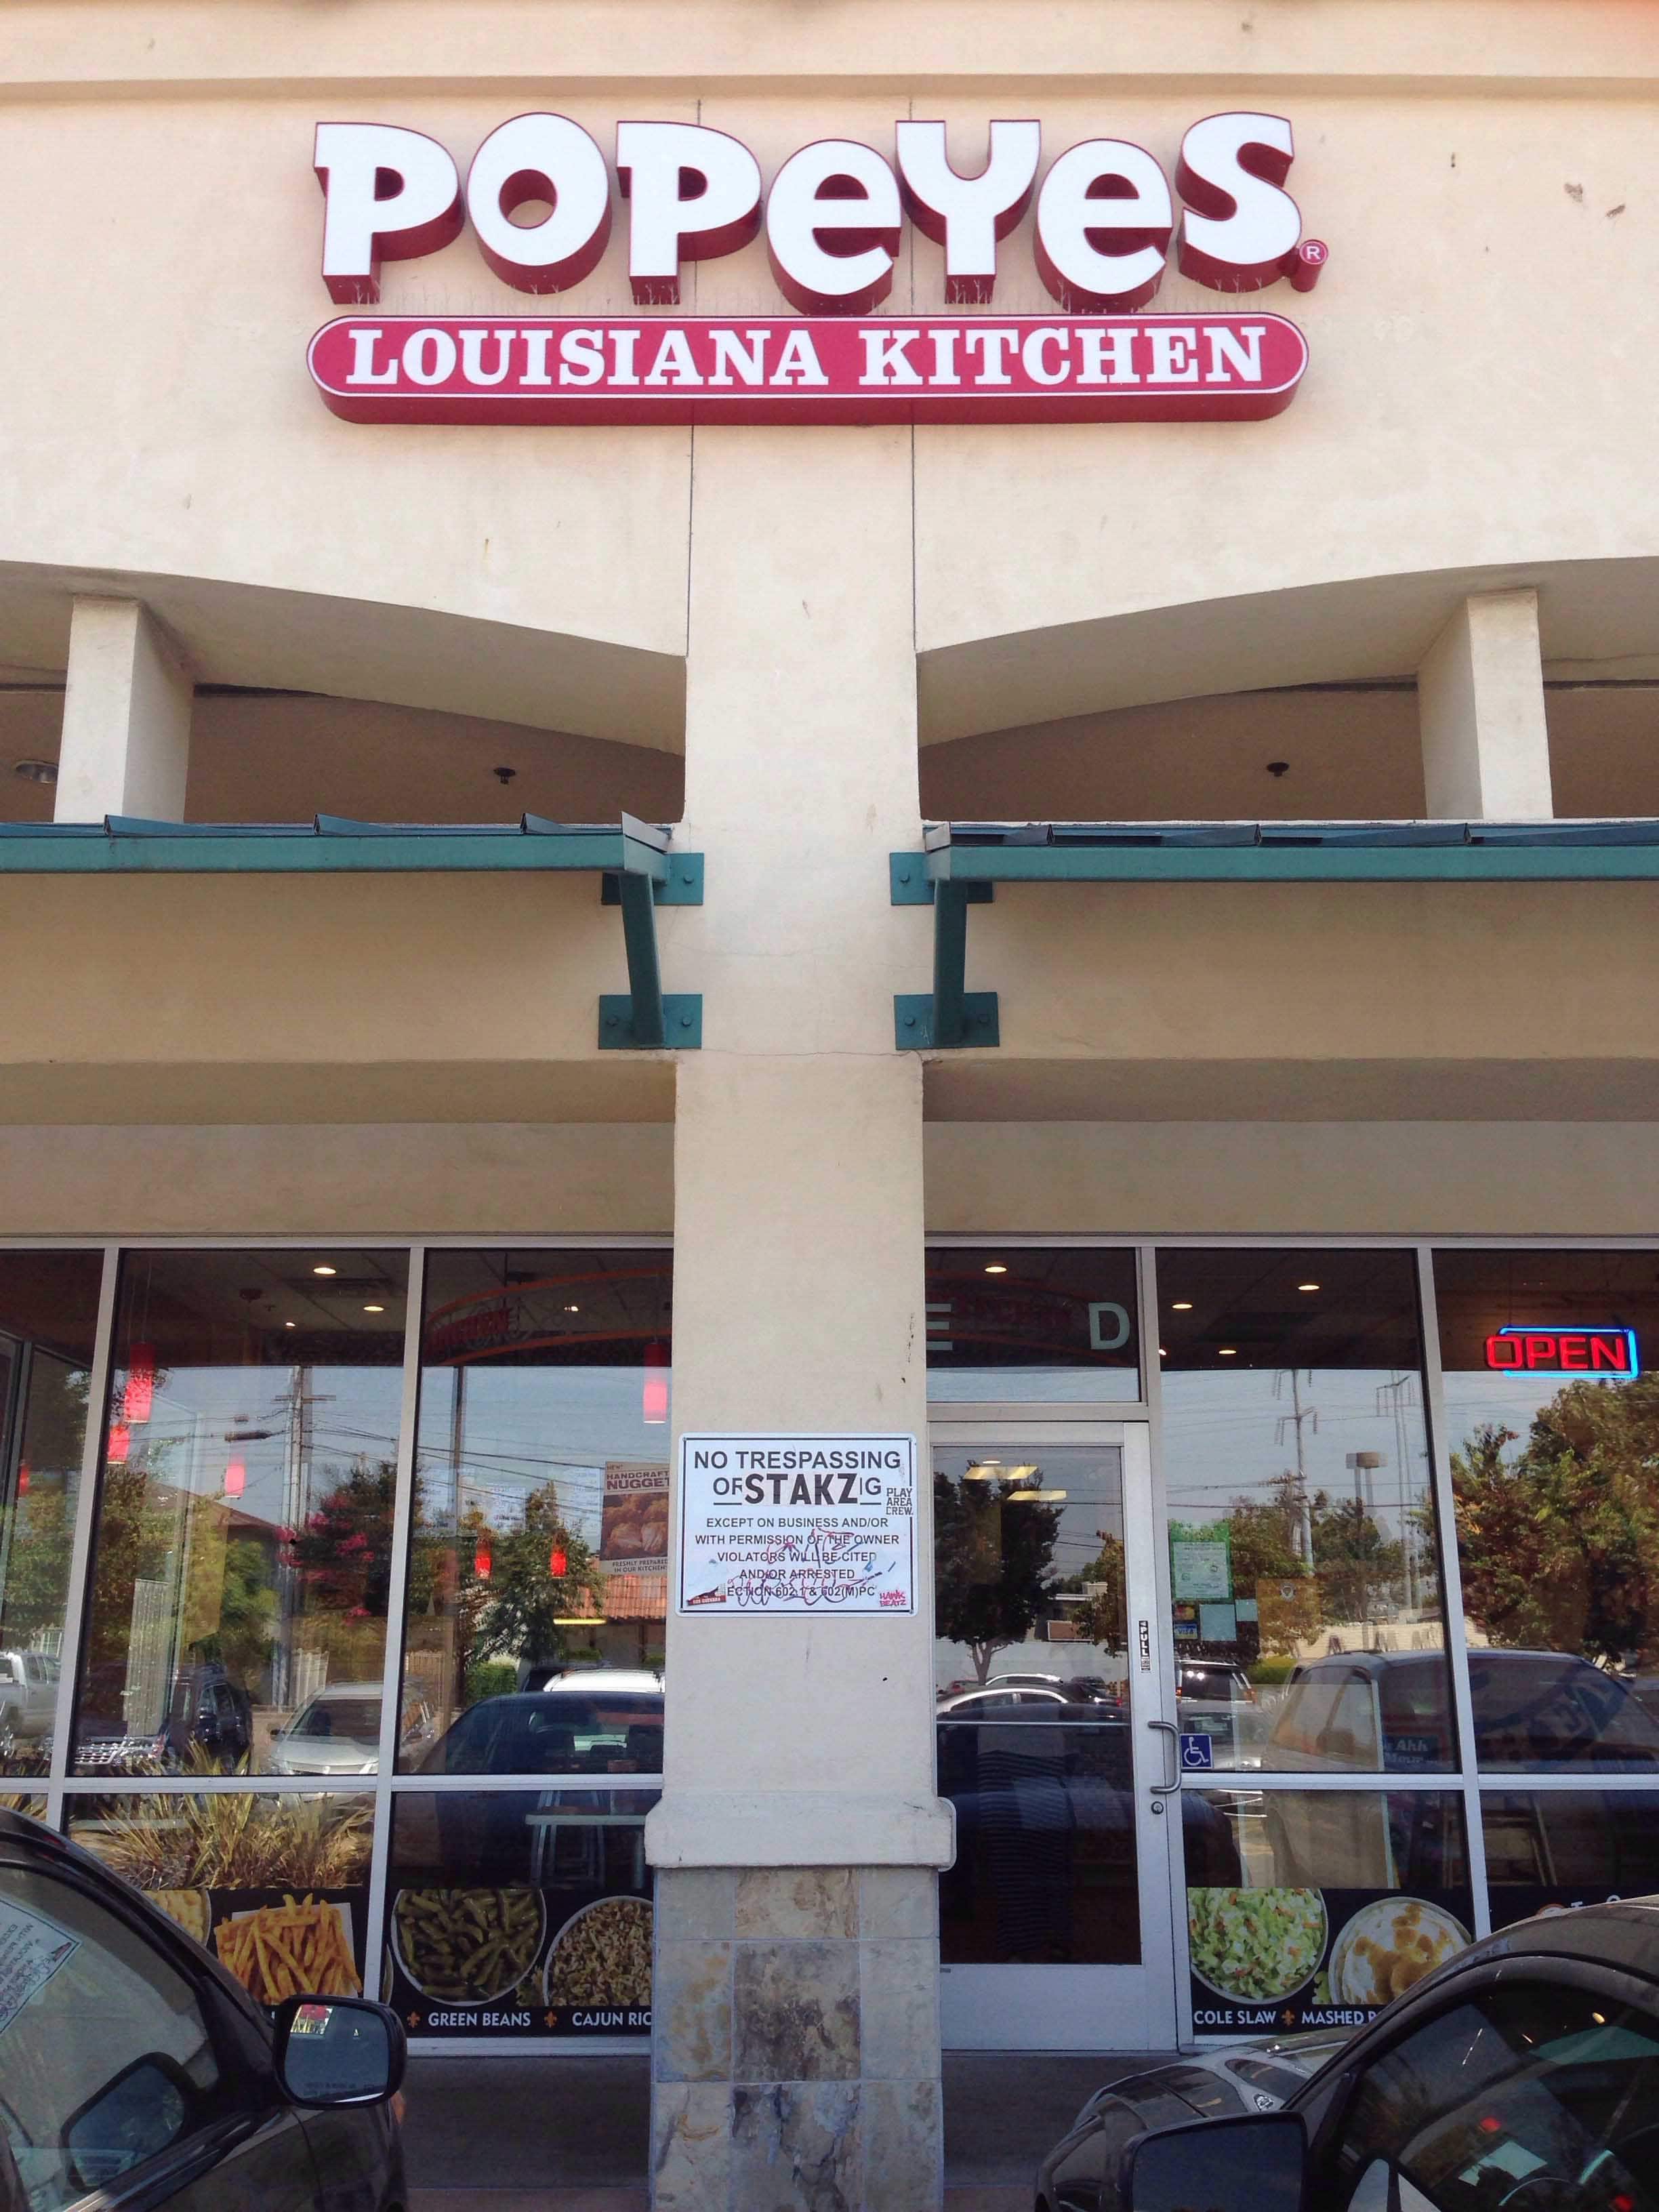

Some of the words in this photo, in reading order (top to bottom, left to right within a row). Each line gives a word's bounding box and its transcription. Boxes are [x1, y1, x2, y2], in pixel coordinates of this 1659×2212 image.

[345, 328, 830, 386] LOUISIANA
[859, 327, 1266, 386] KITCHEN
[1088, 1301, 1130, 1351] D
[1486, 1334, 1626, 1370] OPEN
[694, 1451, 728, 1469] NO
[735, 1450, 901, 1469] TRESPASSING
[745, 1473, 859, 1505] STAKZ
[886, 1488, 913, 1497] PLAY
[886, 1498, 913, 1507] AREA
[706, 1517, 754, 1528] EXCEPT
[757, 1517, 775, 1528] ON
[779, 1517, 838, 1528] BUSINESS
[840, 1517, 888, 1528] AND/OR
[695, 1534, 726, 1545] WITH
[729, 1534, 804, 1545] PERMISSION
[807, 1534, 823, 1545] OF
[827, 1534, 850, 1545] THE
[853, 1534, 899, 1545] OWNER
[717, 1552, 785, 1562] VIOLATORS
[789, 1552, 819, 1562] WILL
[822, 1552, 838, 1562] BE
[839, 1552, 877, 1562] CITED
[739, 1569, 786, 1580] AND/OR
[790, 1569, 855, 1580] ARRESTED
[727, 1586, 773, 1597] ECTION
[1140, 1626, 1148, 1656] PULL
[428, 2012, 478, 2026] GREEN
[482, 2012, 531, 2026] BEANS
[572, 2012, 623, 2026] CAJUN
[1193, 2011, 1233, 2025] COLE
[1237, 2011, 1277, 2025] SLAW
[1301, 2011, 1366, 2025] MASHED
